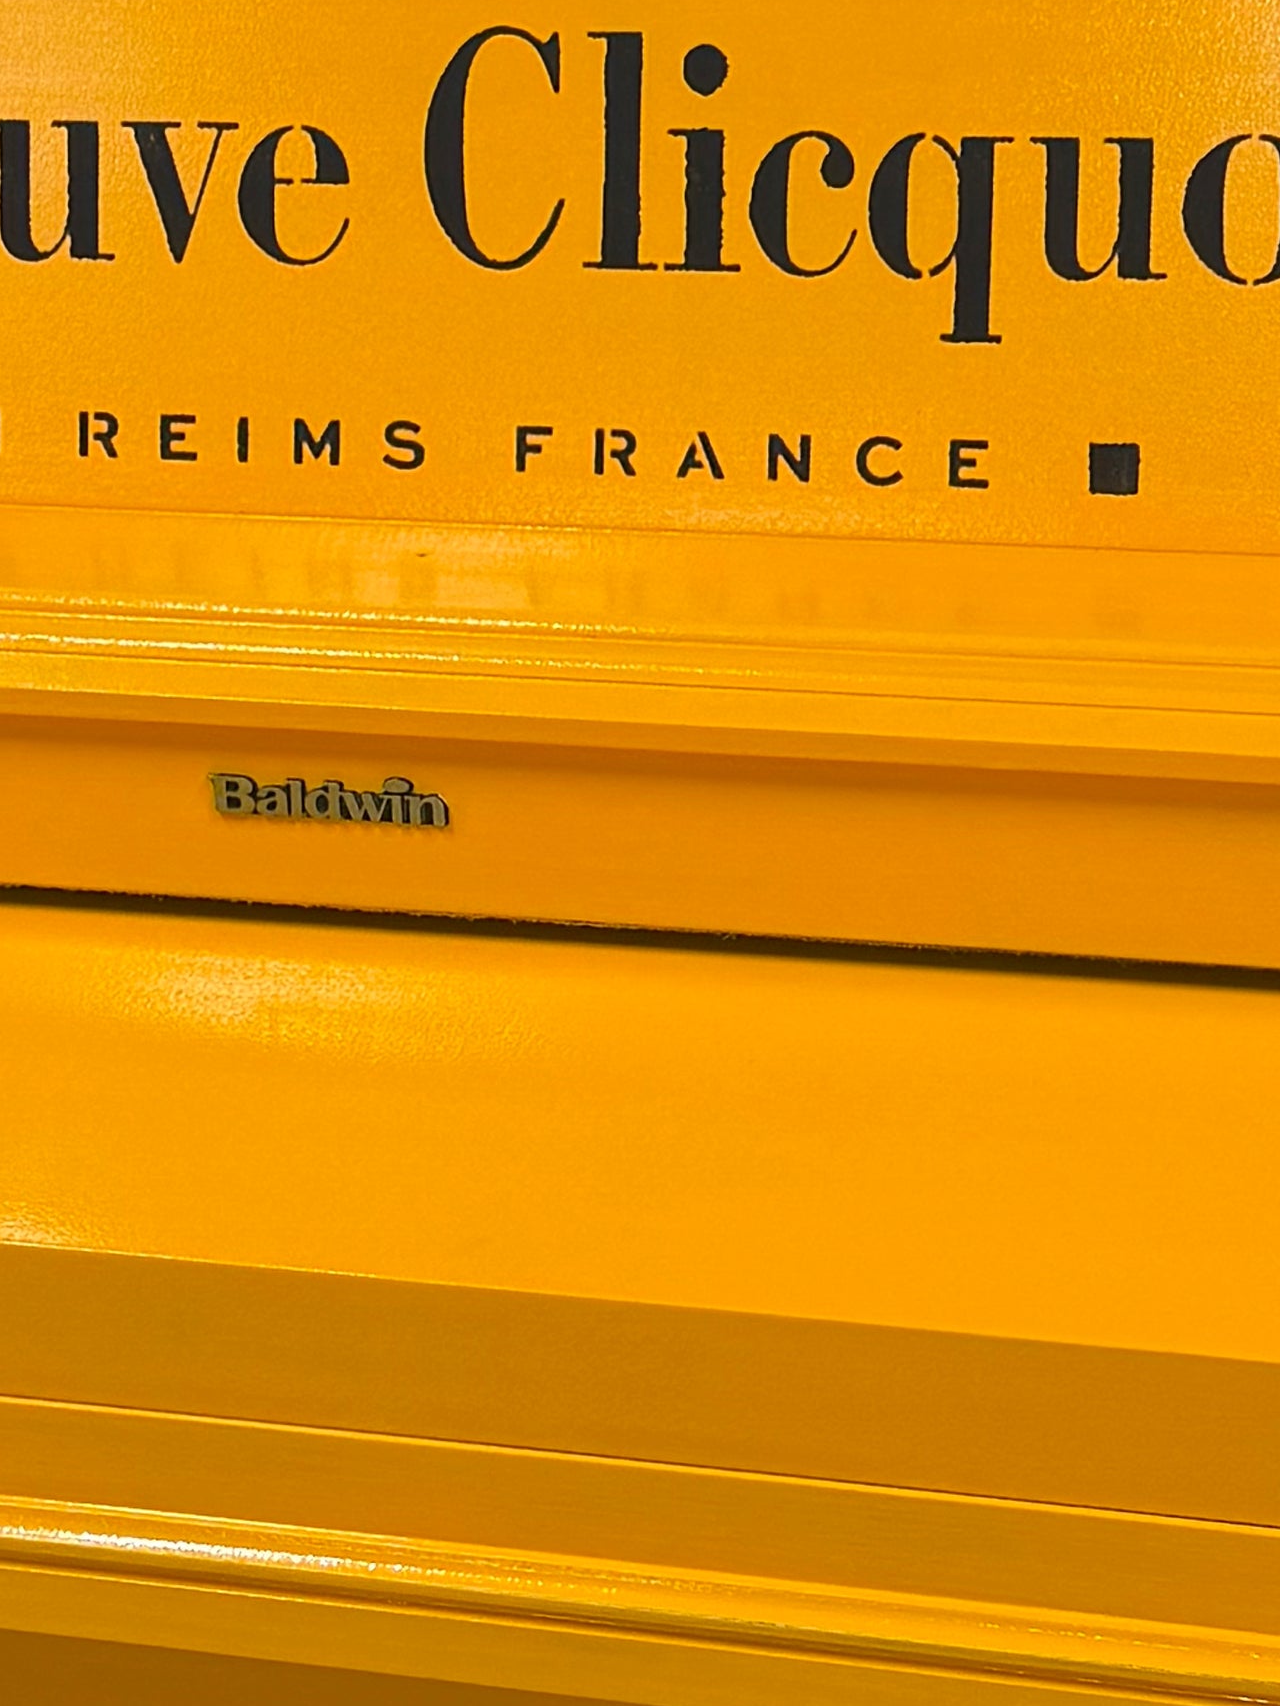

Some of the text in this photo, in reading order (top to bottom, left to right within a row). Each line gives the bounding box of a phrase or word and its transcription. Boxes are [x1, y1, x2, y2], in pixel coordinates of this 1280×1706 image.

[78, 411, 996, 491] REIMS FRANCE
[209, 772, 449, 827] Baldwin
